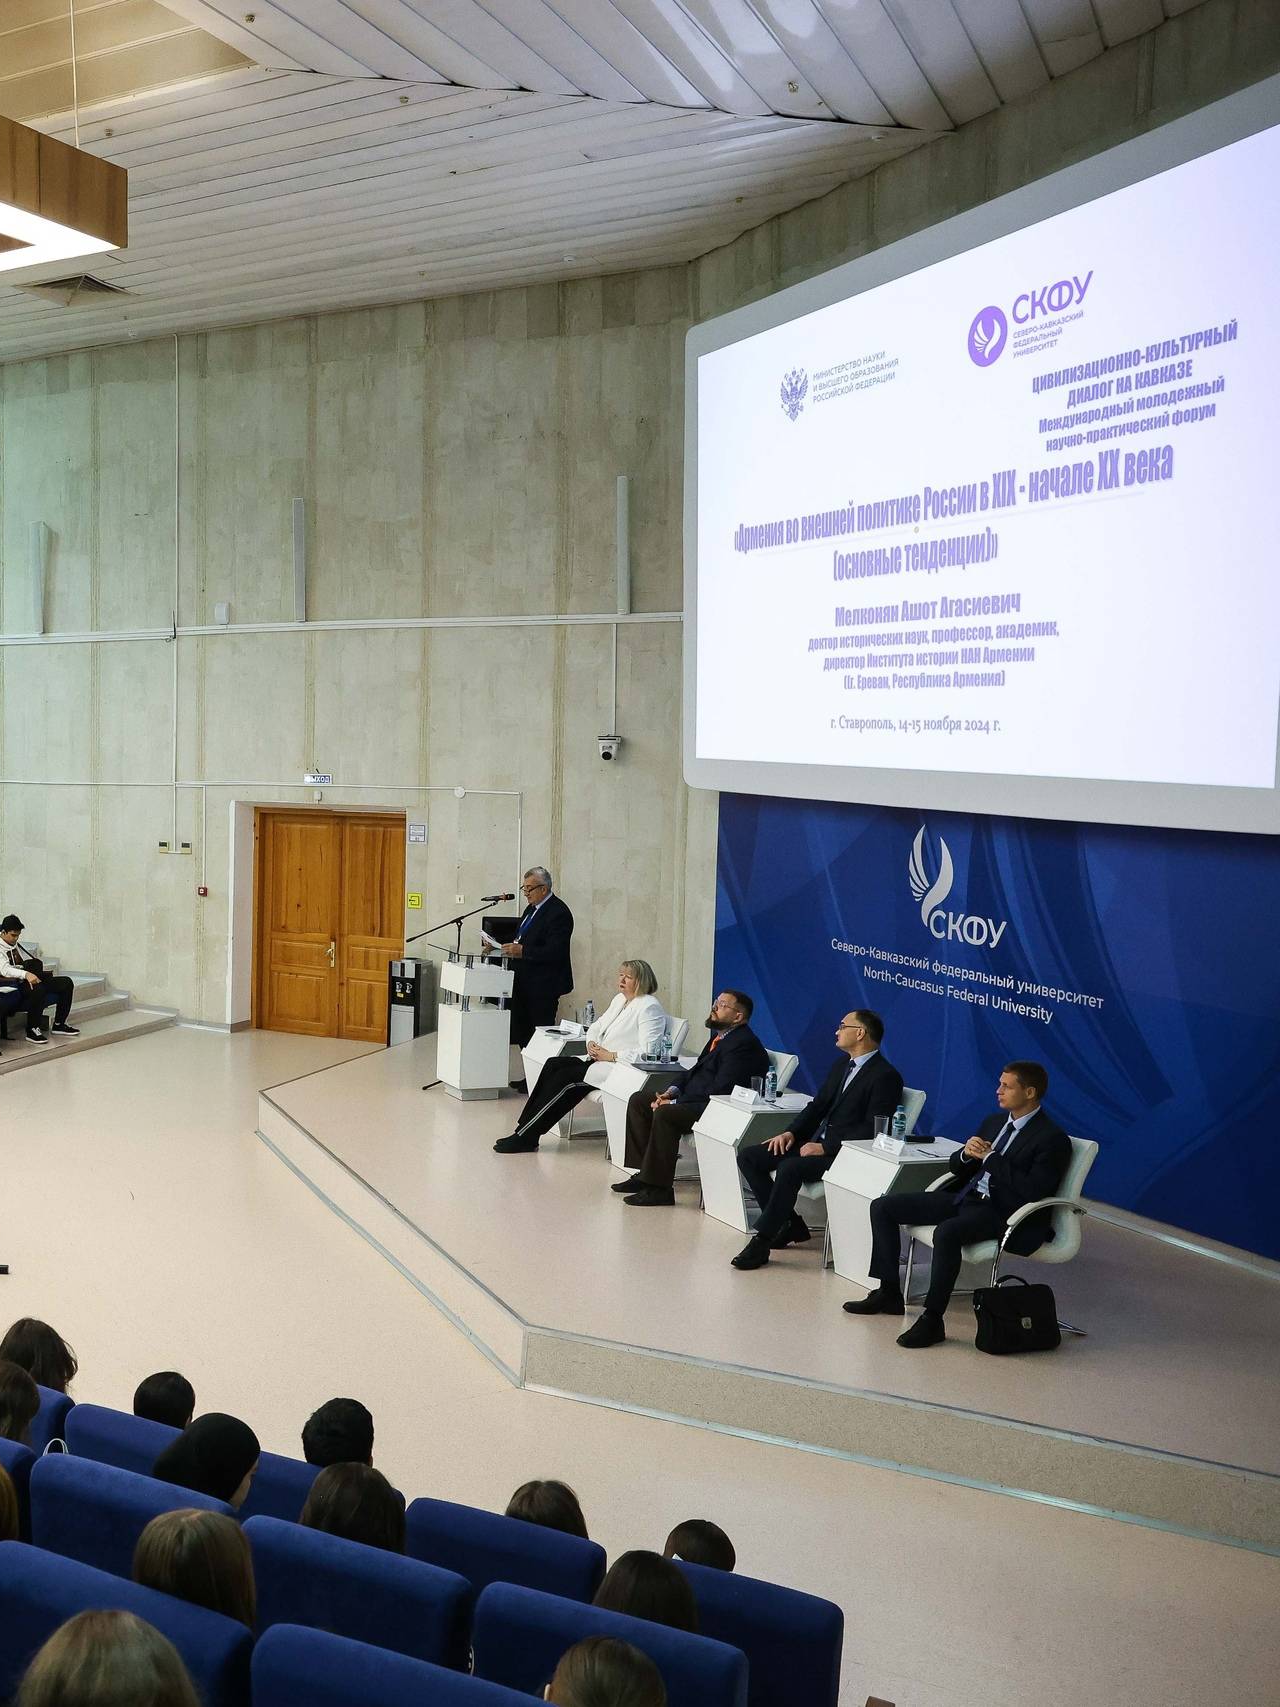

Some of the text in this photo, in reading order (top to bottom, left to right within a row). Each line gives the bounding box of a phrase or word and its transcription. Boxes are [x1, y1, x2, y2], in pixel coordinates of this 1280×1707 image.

[1012, 270, 1094, 324] СКФУ
[1013, 310, 1084, 339] СЕВЕРО-КАВКАЗСКИЙ
[1013, 327, 1063, 348] ФЕДЕРАЛЬНЫЙ
[813, 351, 886, 381] МИНИСТЕРСТВО НАУКИ
[1013, 339, 1058, 359] УНИВЕРСИТЕТ
[1032, 318, 1238, 395] ЦИВИЛИЗАЦИОННО-КУЛЬТУРНЫЙ
[813, 371, 896, 403] РОССИЙСКОЙ ФЕДЕРАЦИИ
[818, 374, 849, 391] ВЫСШЕГО
[850, 358, 899, 381] ОБРАЗОВАНИЯ
[1067, 359, 1193, 409] ДИАЛОГ НА КАВКАЗЕ
[1039, 376, 1225, 434] Международный молодежный
[1046, 403, 1216, 452] научно-практический форум
[735, 520, 784, 554] «Армения
[786, 518, 799, 544] во
[801, 499, 855, 542] внешней
[857, 494, 921, 532] политике
[923, 483, 977, 520] России
[980, 481, 989, 511] в
[992, 469, 1017, 509] XIX
[1028, 460, 1094, 503] начале
[1097, 448, 1120, 491] XX
[1123, 444, 1174, 486] века
[833, 526, 998, 581] (основные тенденции)»
[835, 593, 1021, 627] Мелконян Ашот Агасиевич
[808, 621, 1060, 652] доктор исторических наук, профессор, академик,
[823, 646, 1035, 672] директор Института истории НАН Армении
[857, 674, 891, 691] Ереван,
[892, 672, 951, 690] Республика
[952, 670, 1006, 689] Армения)
[830, 715, 1001, 735] г. Ставрополь, 14-15 ноября 2024 г.
[929, 909, 1008, 949] СКФУ
[831, 938, 1105, 1010] Северо-Кавказский федеральный университет
[863, 965, 1054, 1025] North-Caucasus Federal University
